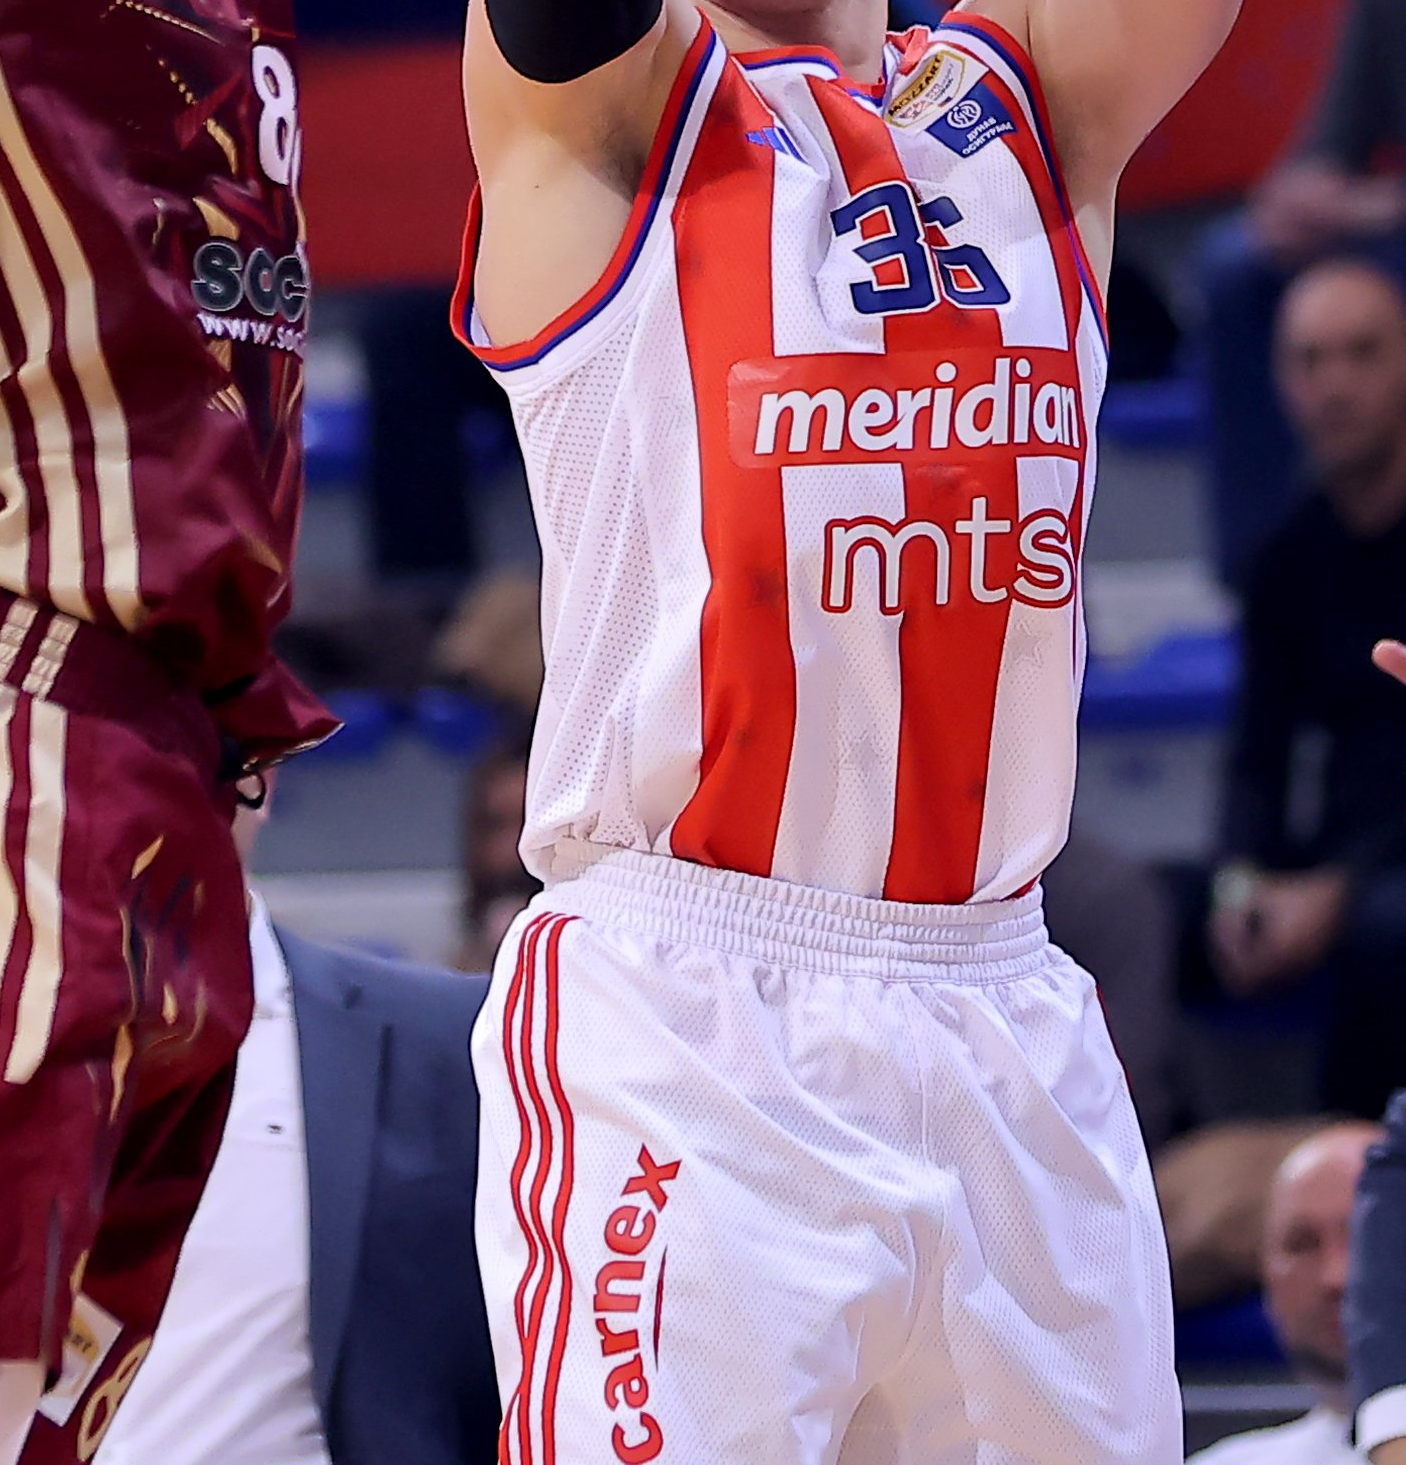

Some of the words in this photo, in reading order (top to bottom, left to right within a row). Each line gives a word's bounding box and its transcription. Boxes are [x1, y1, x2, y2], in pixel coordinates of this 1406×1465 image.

[830, 181, 1012, 315] 36
[754, 357, 1080, 455] meridian
[822, 497, 1075, 614] mts
[593, 1142, 683, 1465] carnex
